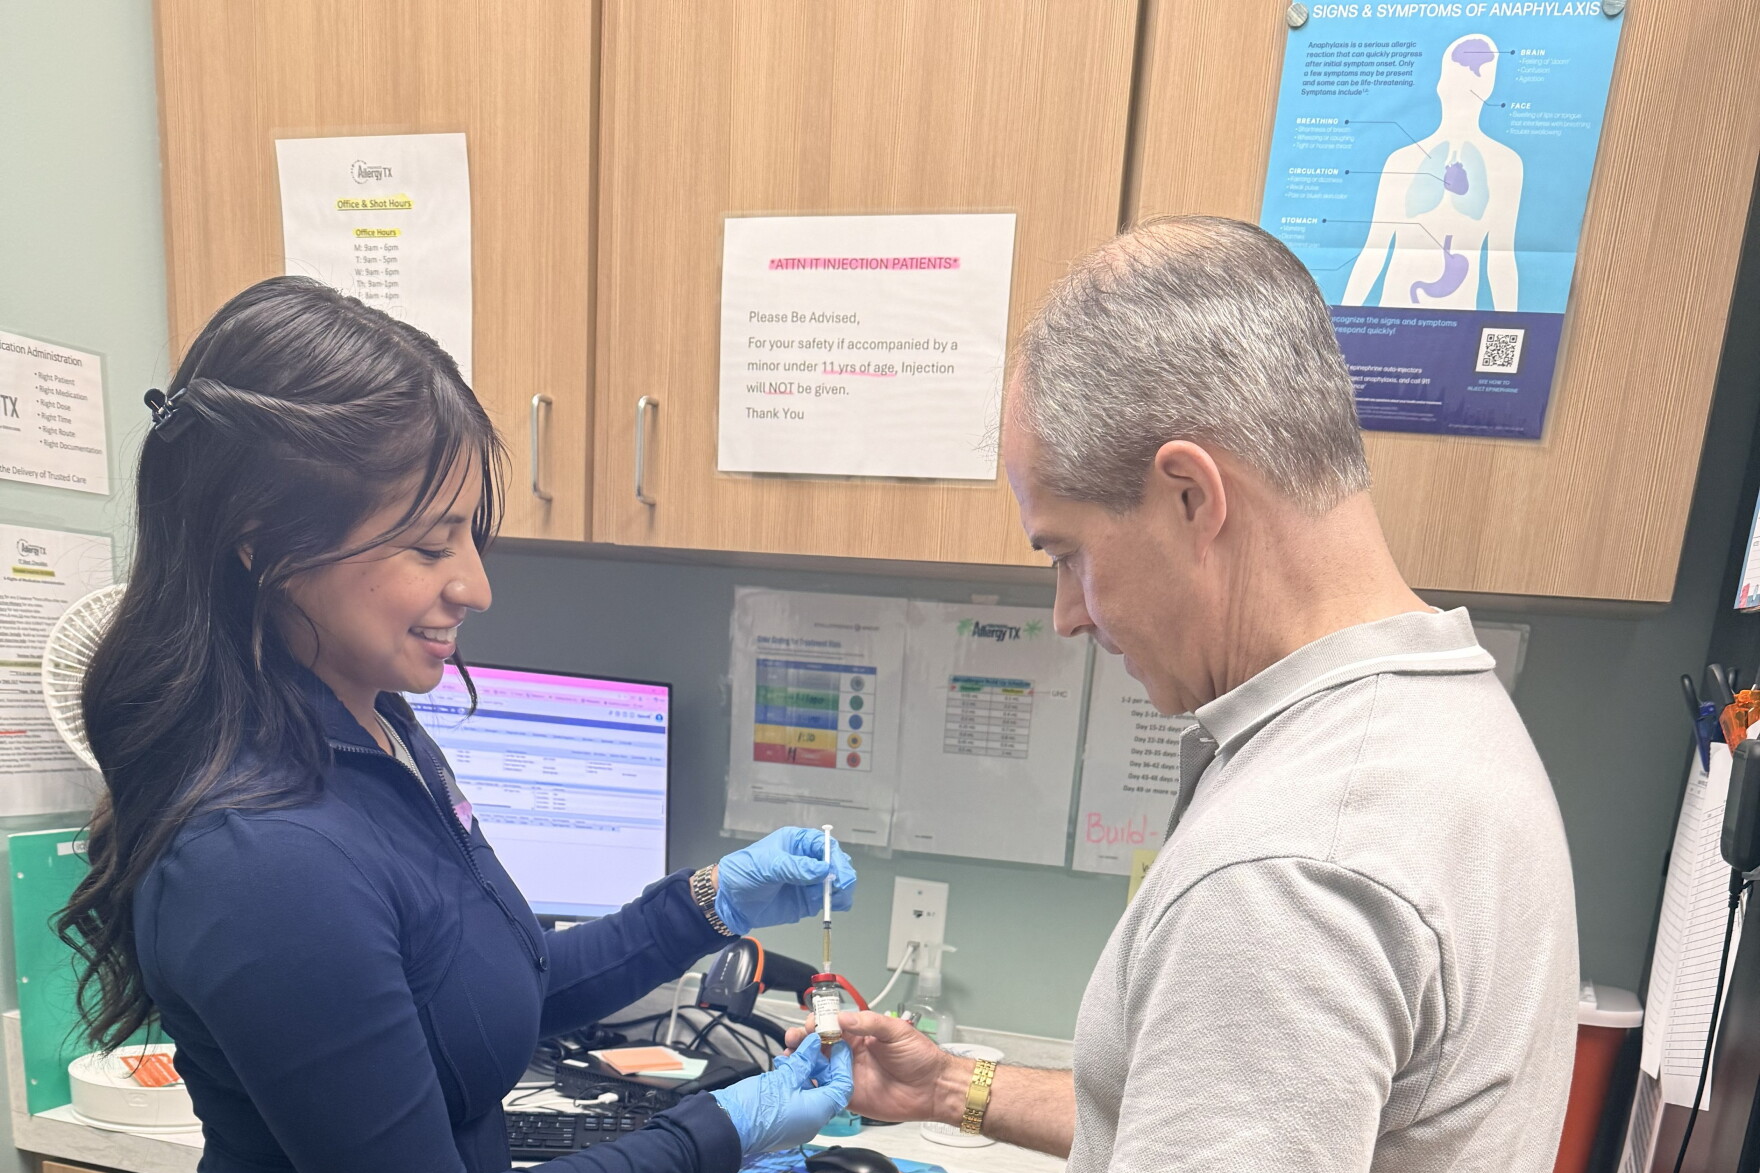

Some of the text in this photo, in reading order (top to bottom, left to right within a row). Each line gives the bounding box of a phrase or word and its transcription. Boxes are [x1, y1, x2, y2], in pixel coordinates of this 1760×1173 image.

[1312, 1, 1600, 18] SIGNS & SYMPTOMS OF ANAPHYLAXIS
[1391, 41, 1416, 49] allergic
[1366, 51, 1389, 59] quickly
[1391, 51, 1422, 59] progress
[1323, 70, 1358, 78] symptoms
[1361, 79, 1415, 87] life-threatening.
[337, 199, 412, 209] Office & Shot Hours
[355, 229, 375, 237] Office
[810, 258, 821, 270] IT
[823, 258, 888, 270] INJECTION
[749, 311, 860, 326] Please Be Advised,
[1380, 318, 1401, 327] signs
[1418, 320, 1457, 328] symptoms
[748, 337, 958, 353] For your safety if accompanied by a
[27, 346, 82, 367] Administration
[747, 360, 954, 376] minor under 11 yrs of age, Injection
[38, 371, 75, 386] Right Patient
[39, 385, 88, 401] Right Medication
[747, 382, 849, 397] will NOT be given.
[40, 398, 71, 411] Right Dose
[41, 412, 72, 424] Right Time
[746, 407, 805, 420] Thank You
[42, 425, 76, 438] Right Route
[43, 439, 103, 455] Right Documentation
[12, 466, 39, 479] Delivery
[39, 470, 47, 479] of
[48, 472, 71, 482] Trusted
[72, 474, 87, 484] Care
[1008, 626, 1021, 640] TX
